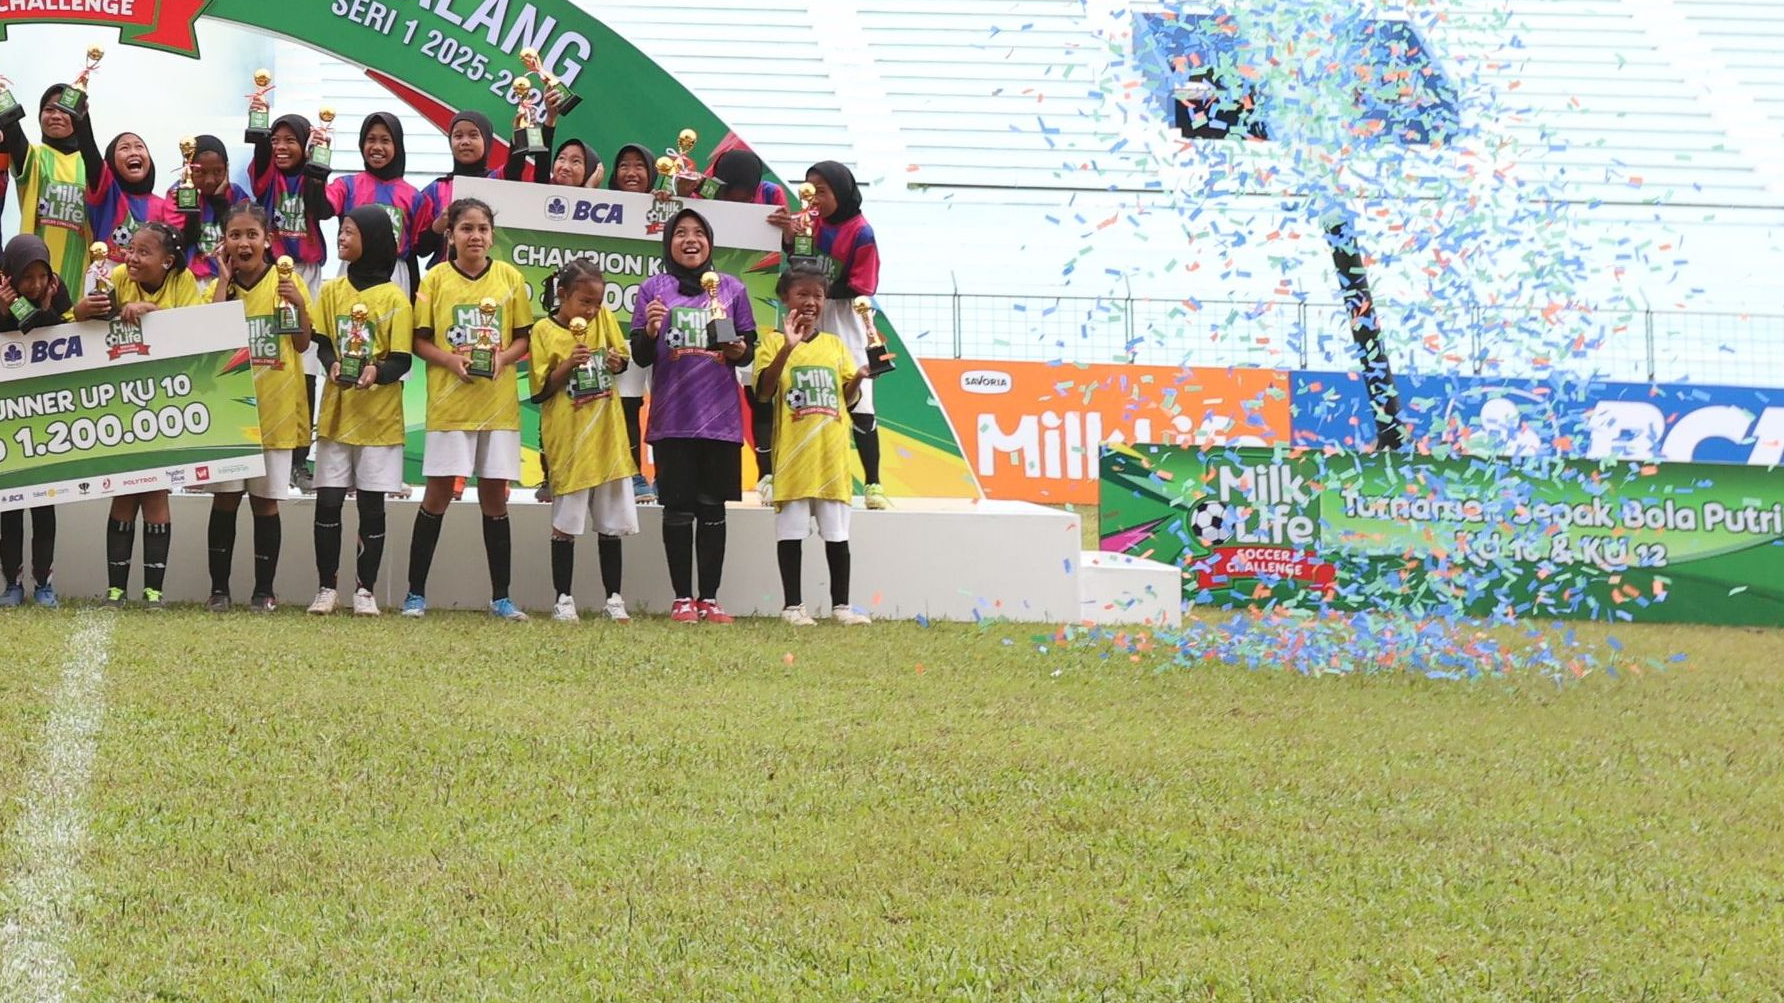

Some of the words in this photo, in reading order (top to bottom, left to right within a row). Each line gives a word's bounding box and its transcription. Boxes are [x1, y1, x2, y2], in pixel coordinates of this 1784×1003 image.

[403, 19, 419, 45] 1
[45, 182, 84, 205] Milk
[49, 201, 85, 223] Life
[572, 200, 624, 225] BCA
[655, 200, 681, 213] Milk
[512, 245, 645, 275] CHAMPION
[30, 335, 84, 364] BCA
[117, 331, 142, 345] Life
[80, 384, 116, 408] UP
[120, 377, 156, 408] KU
[160, 374, 192, 398] 10
[796, 369, 835, 390] Milk
[964, 375, 1008, 387] SAVORIA
[804, 387, 838, 408] Life
[15, 402, 211, 458] 1.200.000
[123, 476, 158, 487] POLYTRON
[1219, 464, 1310, 508] Milk
[1623, 498, 1696, 531] Bola
[1703, 501, 1784, 535] Putri
